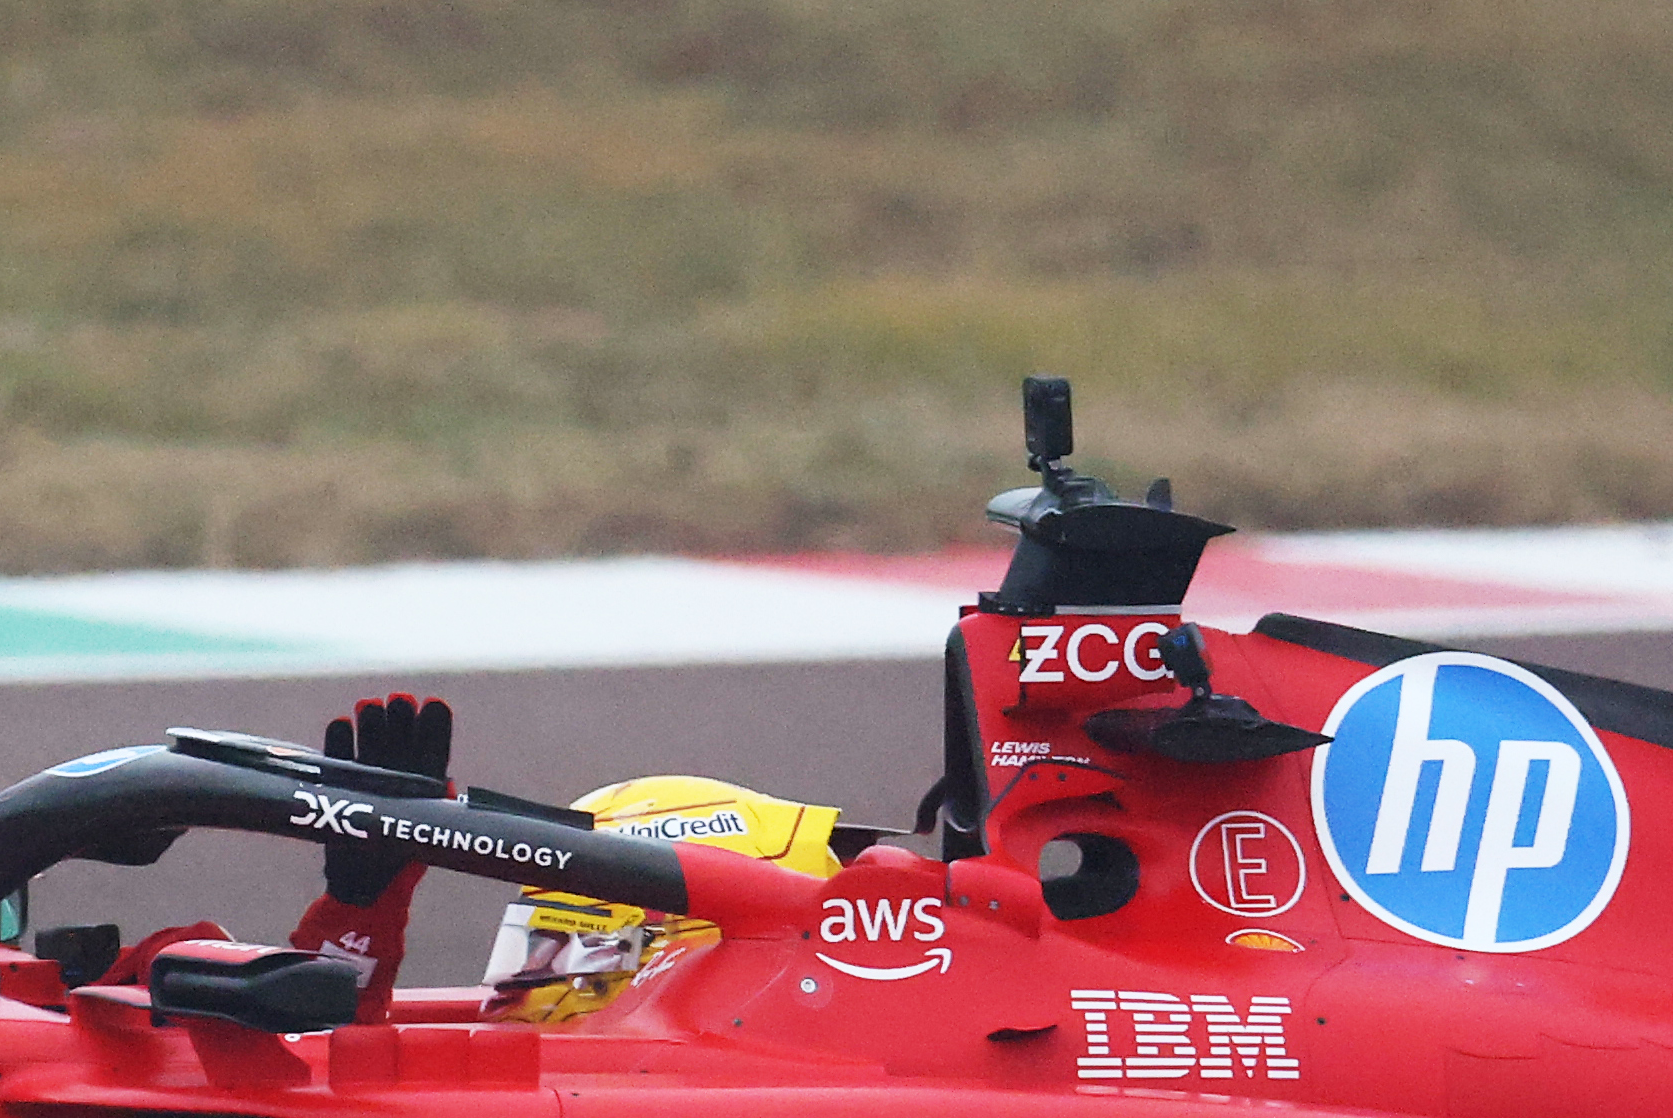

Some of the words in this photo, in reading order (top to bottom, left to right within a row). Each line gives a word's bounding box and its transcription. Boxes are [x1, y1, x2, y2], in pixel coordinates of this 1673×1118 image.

[990, 741, 1051, 755] LEWIS
[290, 790, 375, 839] DXC
[380, 815, 573, 871] TECHNOLOGY
[1366, 655, 1582, 950] hp
[1221, 823, 1277, 908] E
[339, 930, 372, 956] 44
[820, 897, 945, 942] aws
[1070, 990, 1301, 1080] IBM
